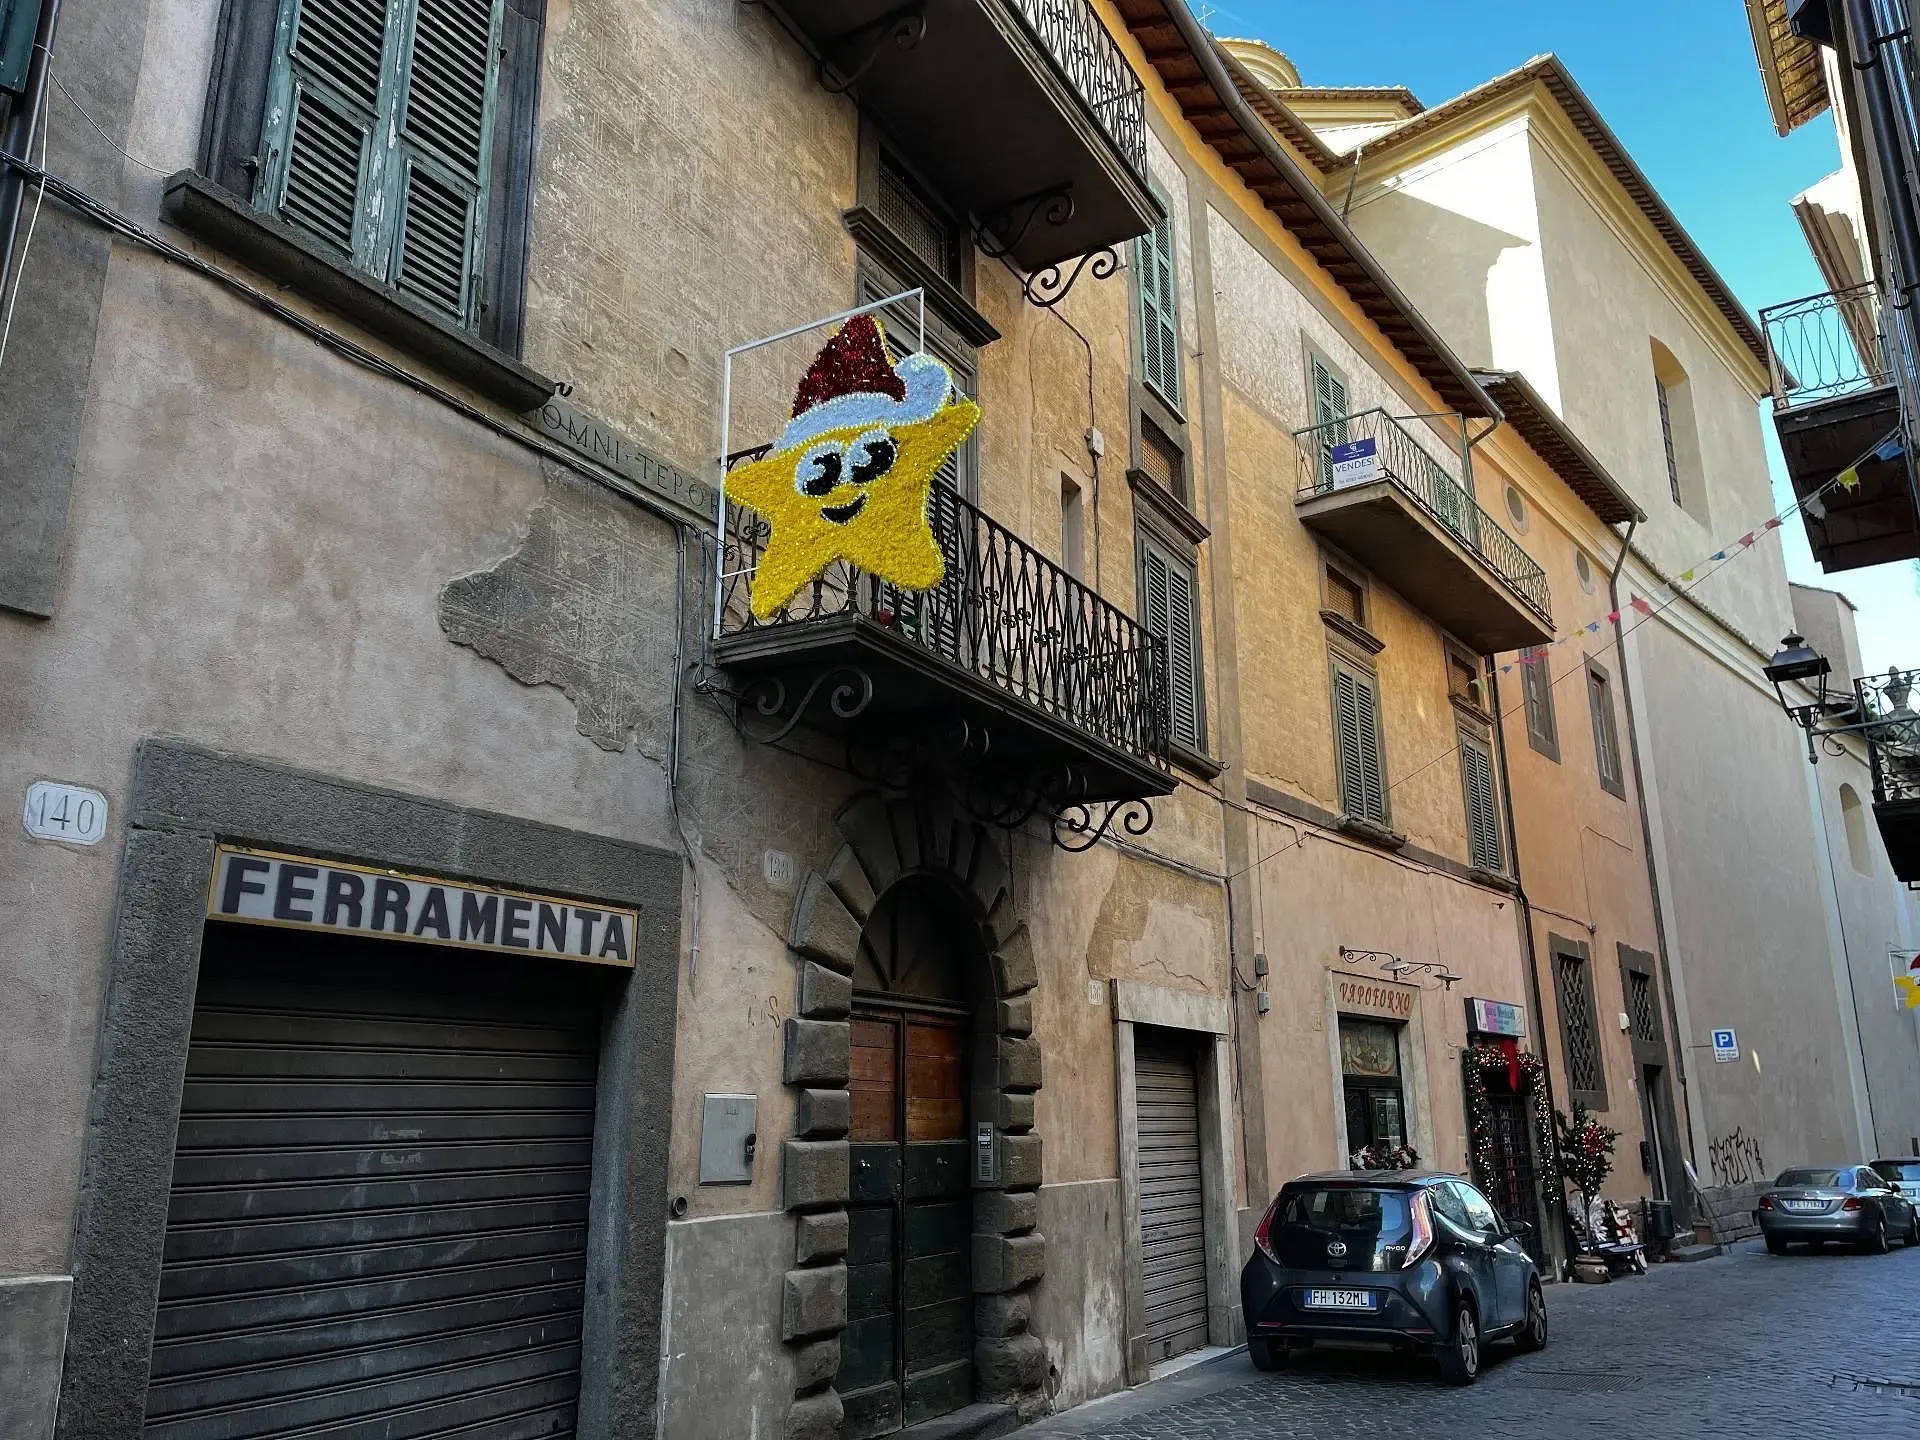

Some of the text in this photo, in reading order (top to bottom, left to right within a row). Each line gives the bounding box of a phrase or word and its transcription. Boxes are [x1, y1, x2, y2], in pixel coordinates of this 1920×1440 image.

[541, 404, 619, 464] OMNI
[1335, 457, 1375, 473] VENDESI
[37, 791, 95, 835] 140
[220, 855, 630, 962] FERRAMENTA
[1339, 982, 1411, 1016] VAPOFORNO
[1718, 1033, 1730, 1047] P
[1312, 1290, 1328, 1304] FH
